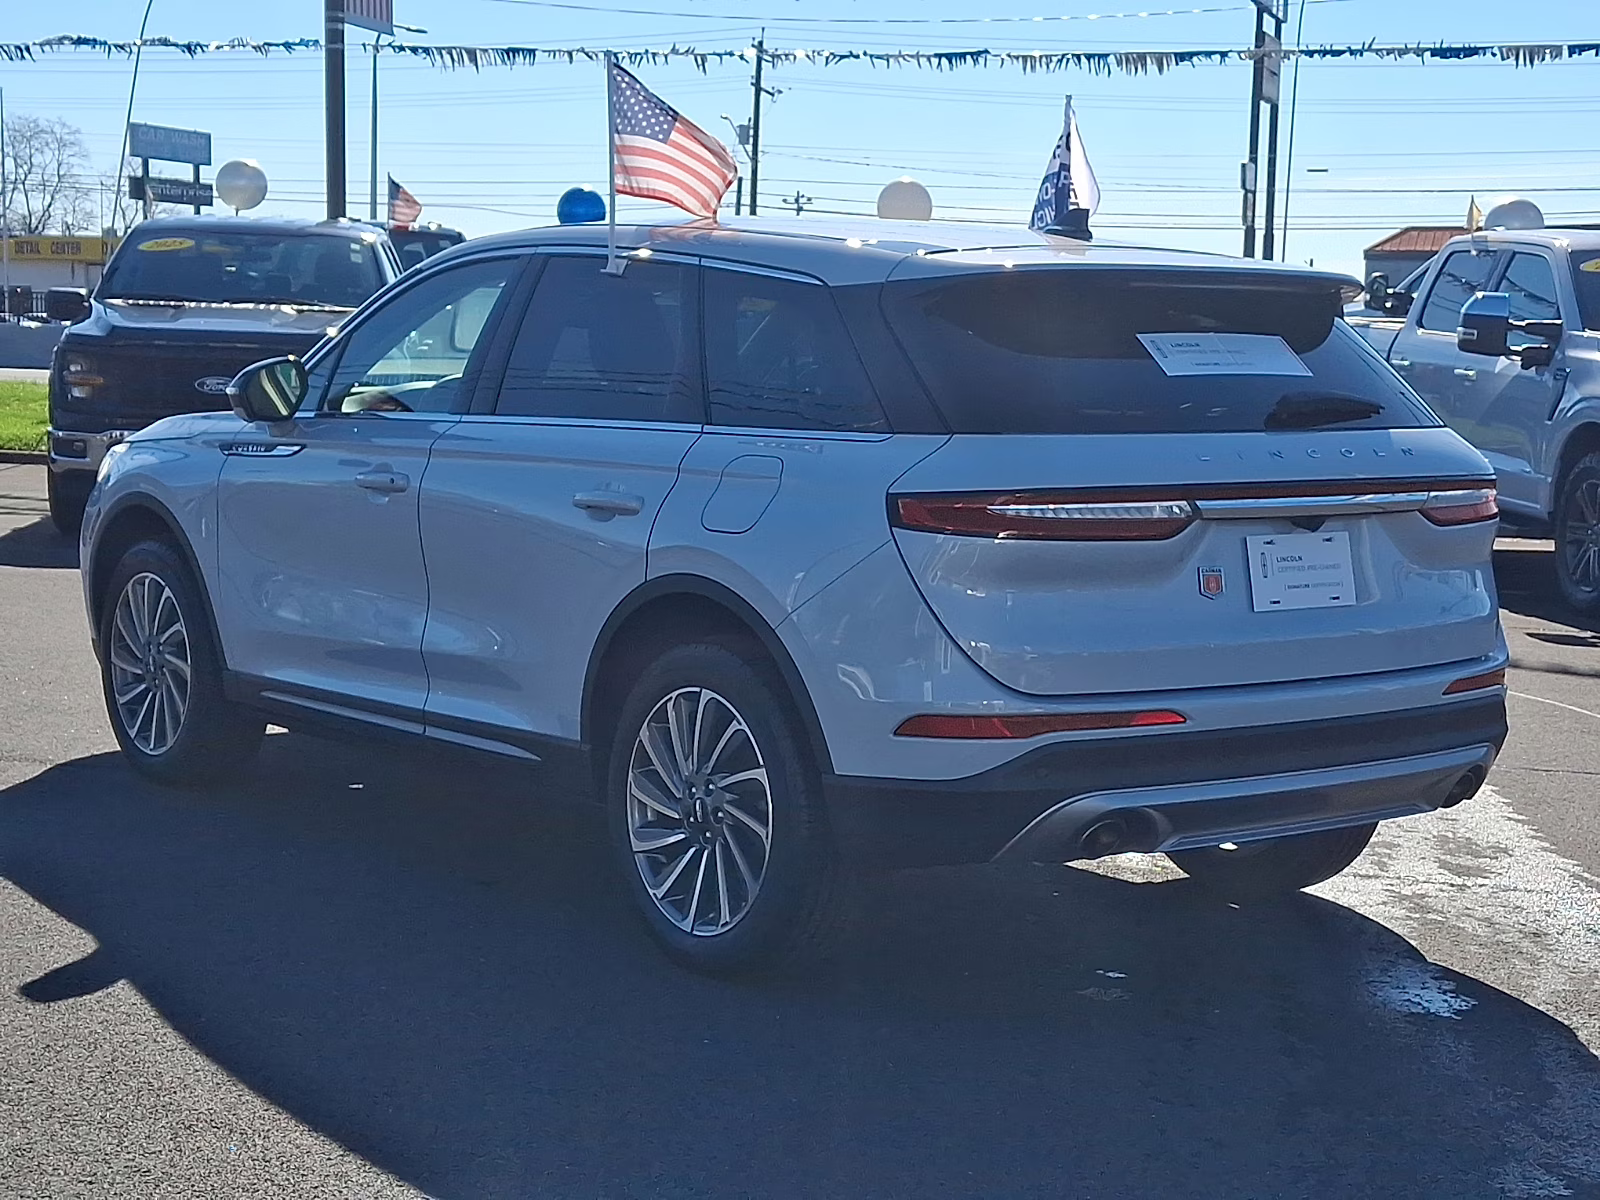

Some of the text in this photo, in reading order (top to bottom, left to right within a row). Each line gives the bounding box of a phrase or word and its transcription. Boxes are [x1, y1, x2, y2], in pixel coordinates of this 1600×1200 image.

[138, 126, 206, 148] CAR WASH
[14, 240, 82, 255] DETAIL CENTER
[1195, 446, 1416, 462] LINCOLN
[1276, 555, 1303, 563] LINCOLN
